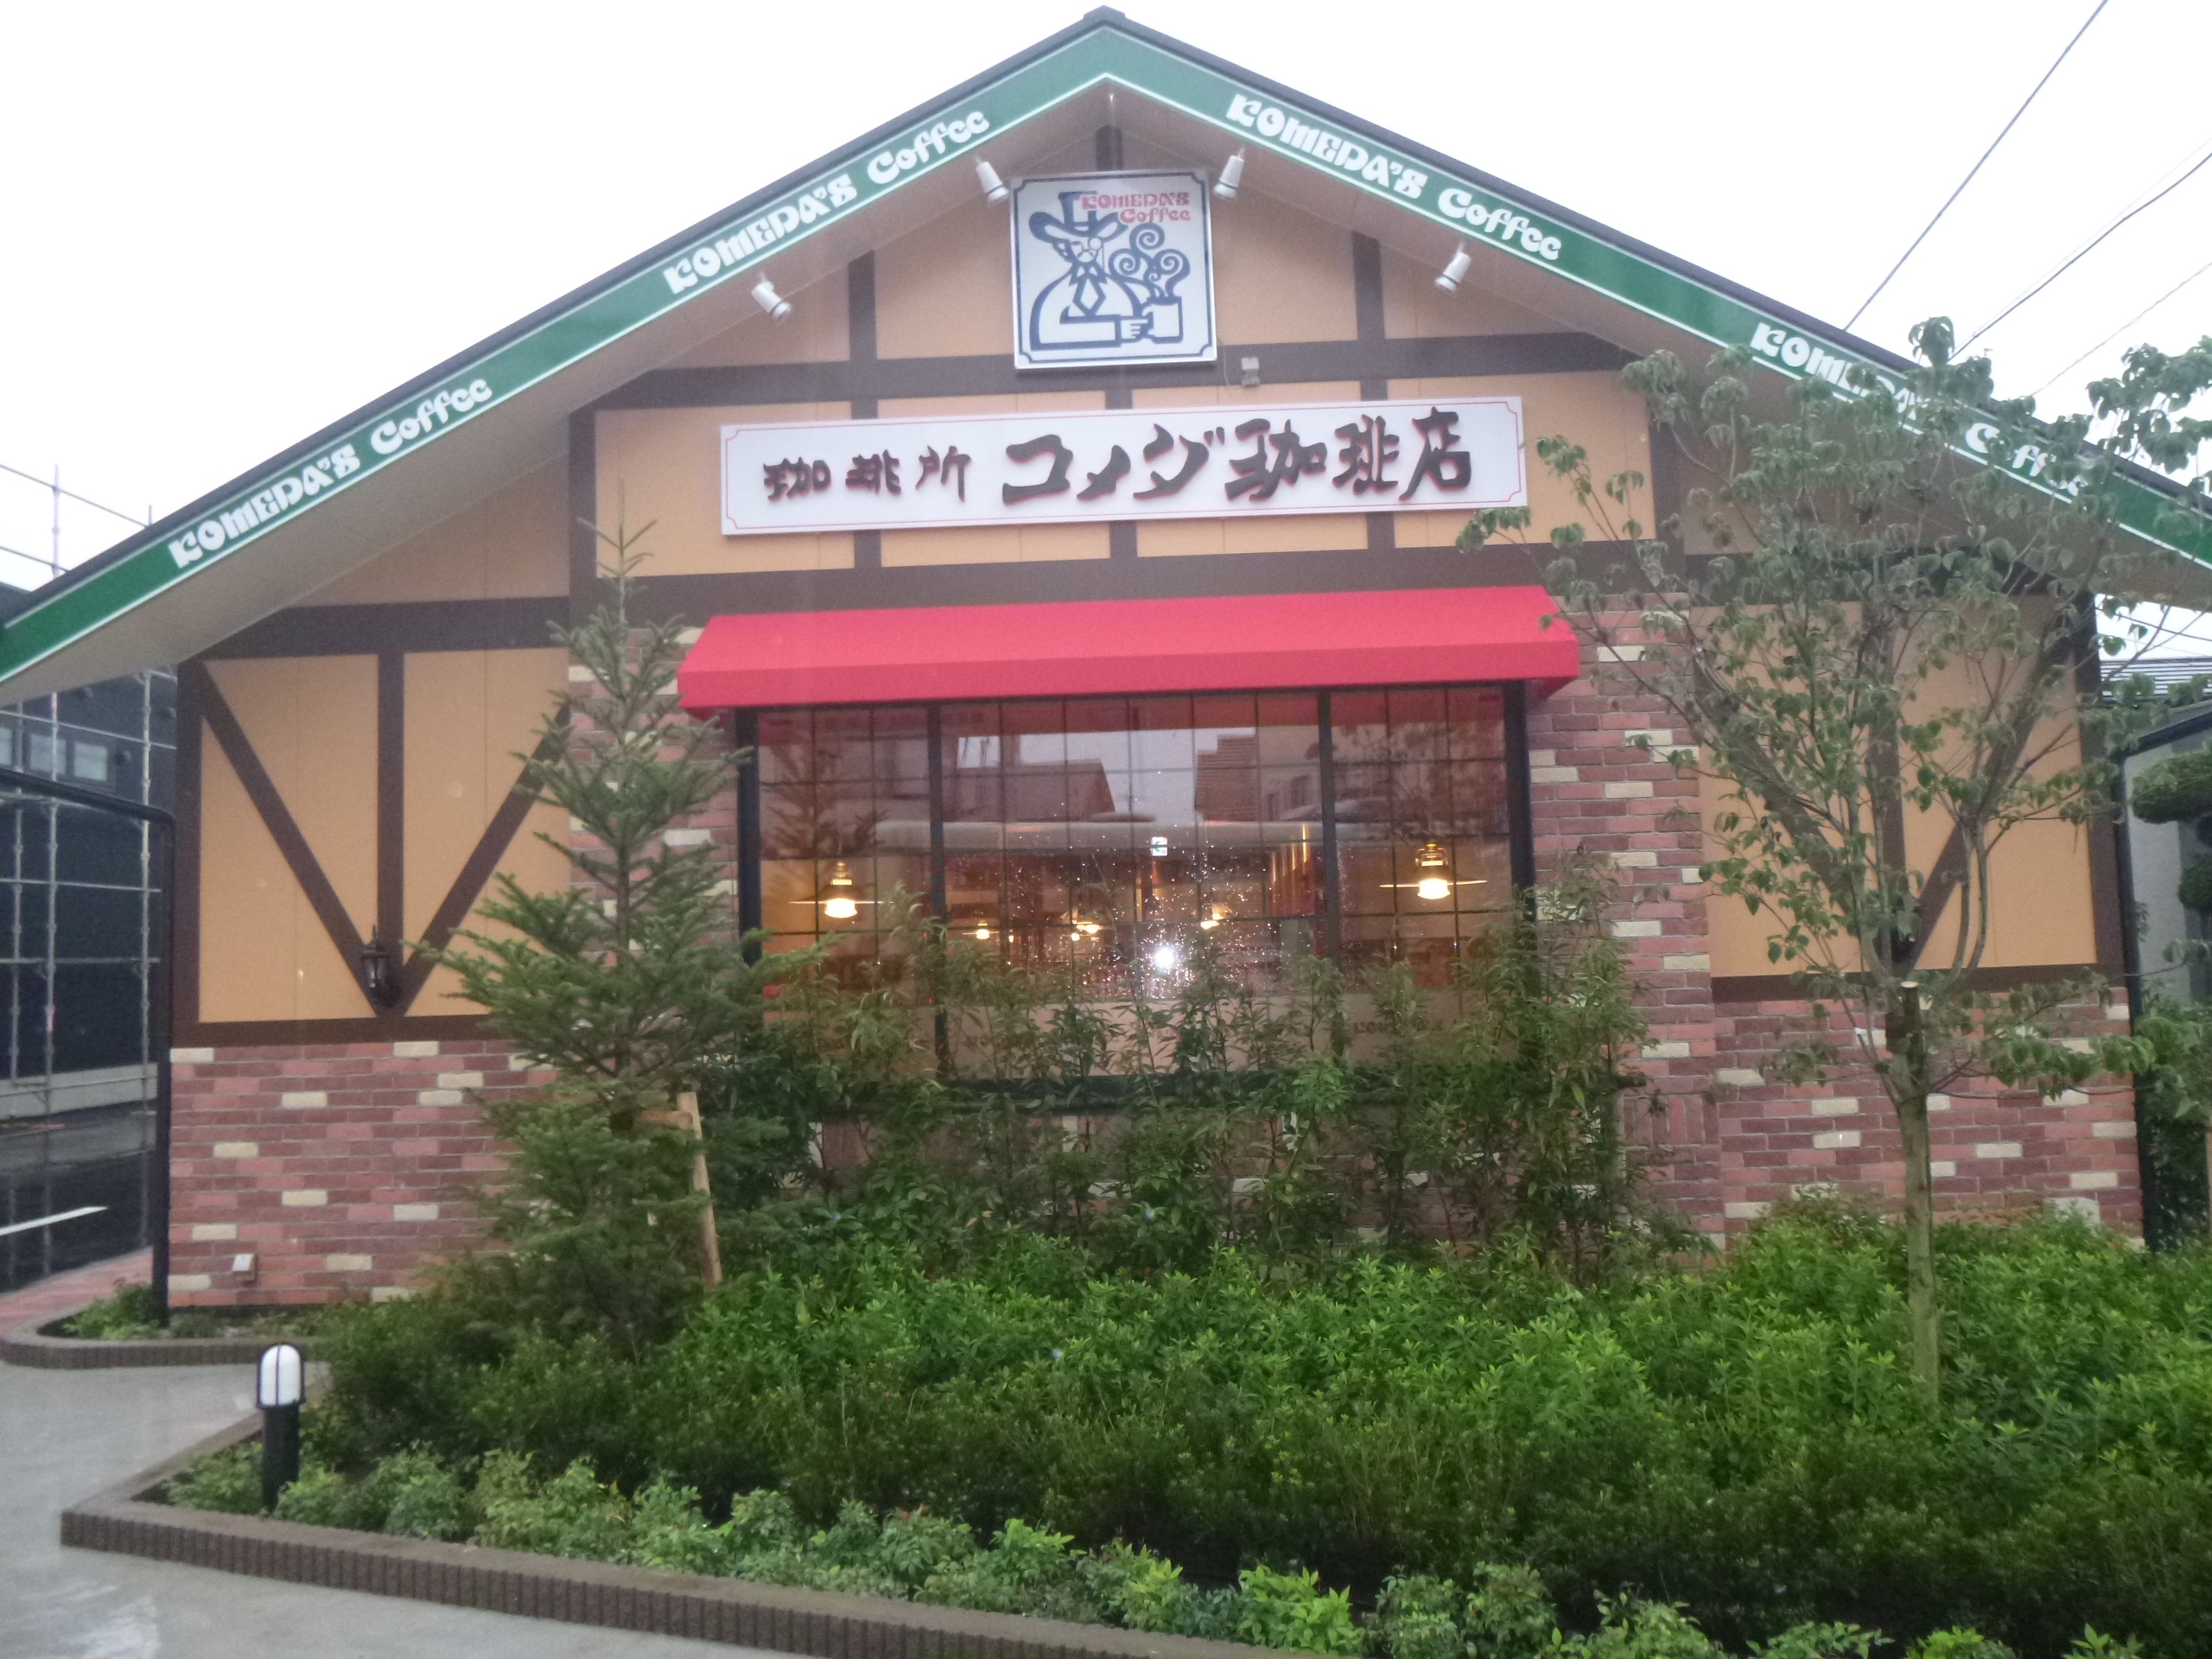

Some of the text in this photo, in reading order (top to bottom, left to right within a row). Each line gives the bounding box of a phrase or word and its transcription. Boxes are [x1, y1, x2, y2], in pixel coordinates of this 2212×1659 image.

[663, 111, 990, 295] KOMEDA'S Coffee
[1082, 192, 1191, 210] KOMEDA'S
[1119, 207, 1191, 223] Coffee
[1225, 93, 1562, 260] KOMEDA'S Coffee
[168, 378, 493, 569] KOMEDA'S Coffee
[1002, 406, 1471, 506] コメダ珈琲店
